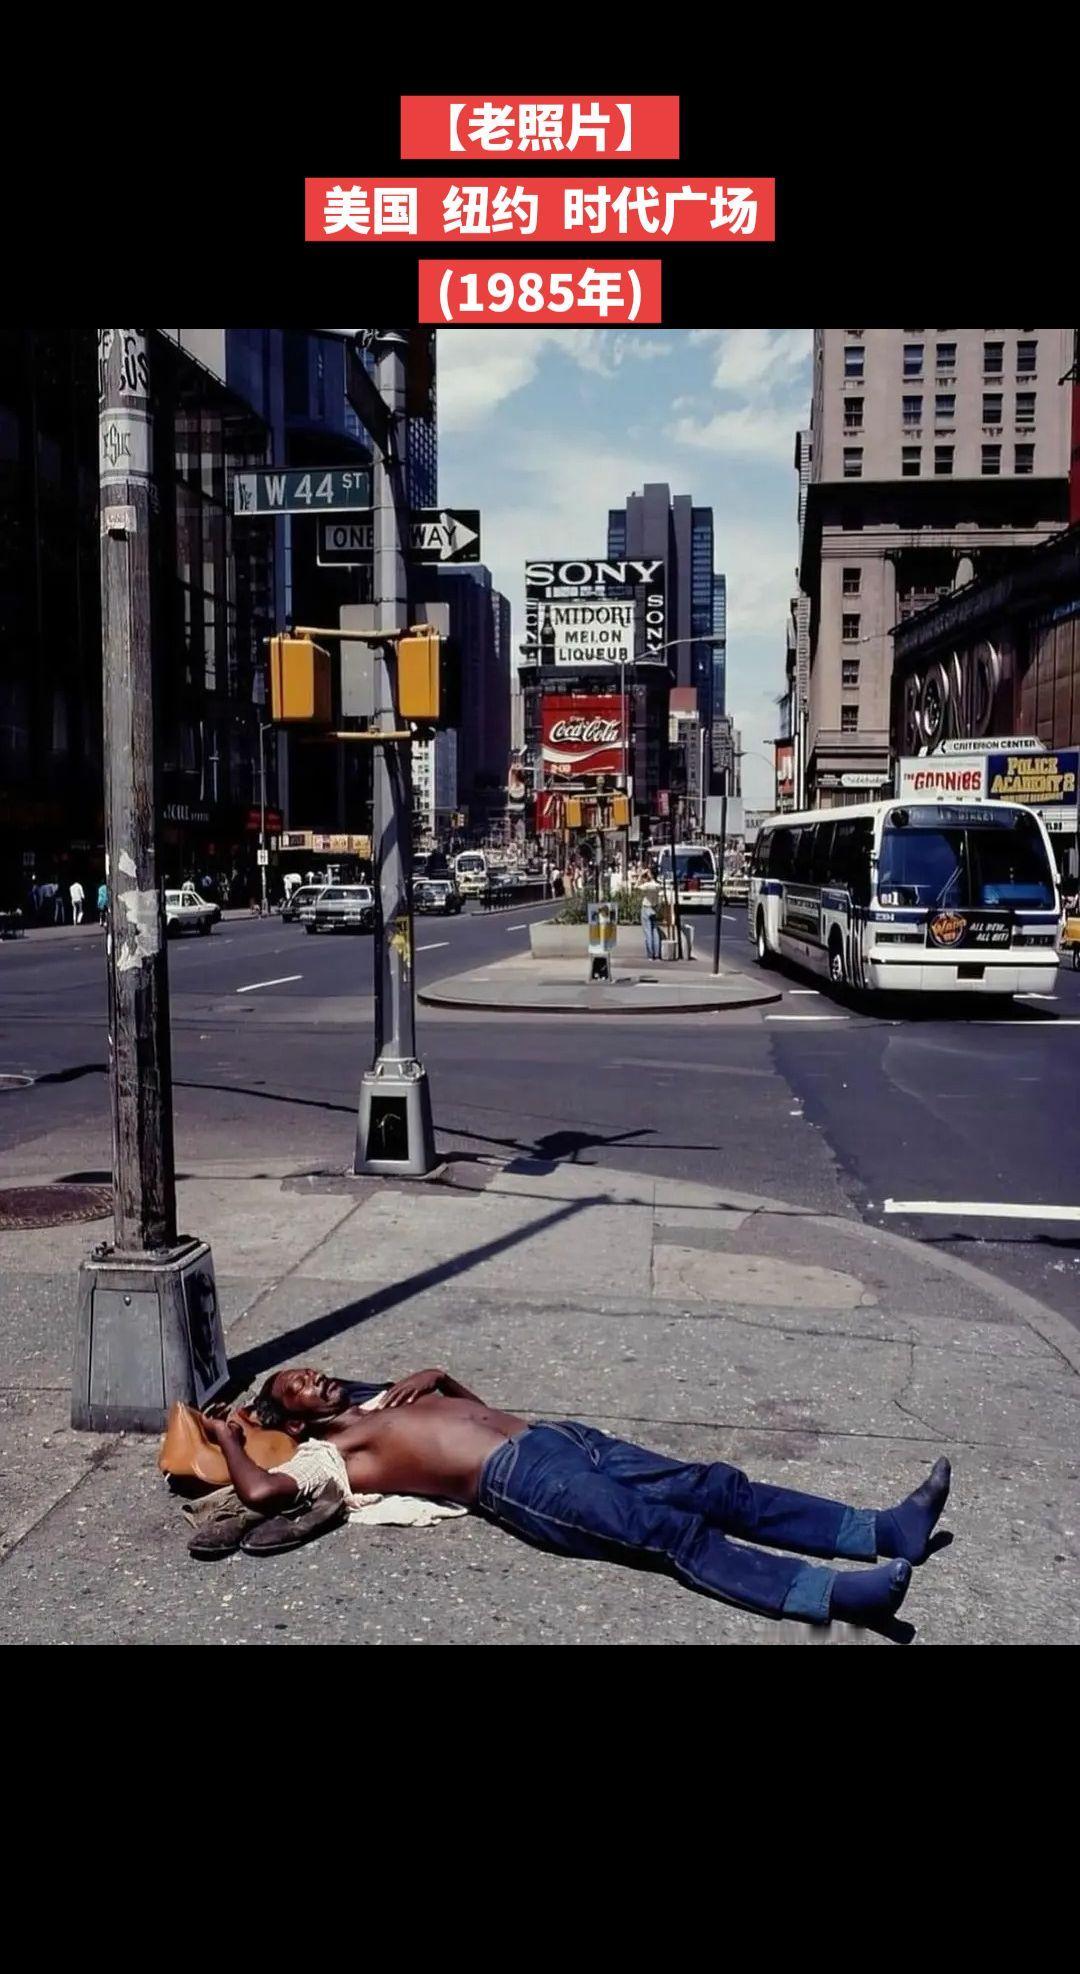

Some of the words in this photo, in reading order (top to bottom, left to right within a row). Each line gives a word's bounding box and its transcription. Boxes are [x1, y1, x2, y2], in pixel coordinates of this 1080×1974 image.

[265, 475, 286, 506] W
[294, 473, 334, 504] 44
[342, 472, 362, 489] ST
[333, 527, 374, 548] ONE
[410, 525, 457, 547] WAY
[526, 560, 663, 586] SONY
[554, 606, 632, 627] MIDORI
[646, 594, 664, 654] SONY
[565, 630, 622, 643] MELON
[953, 740, 1000, 751] CRITERION
[1000, 739, 1036, 749] CENTER
[1007, 757, 1059, 774] POLICE
